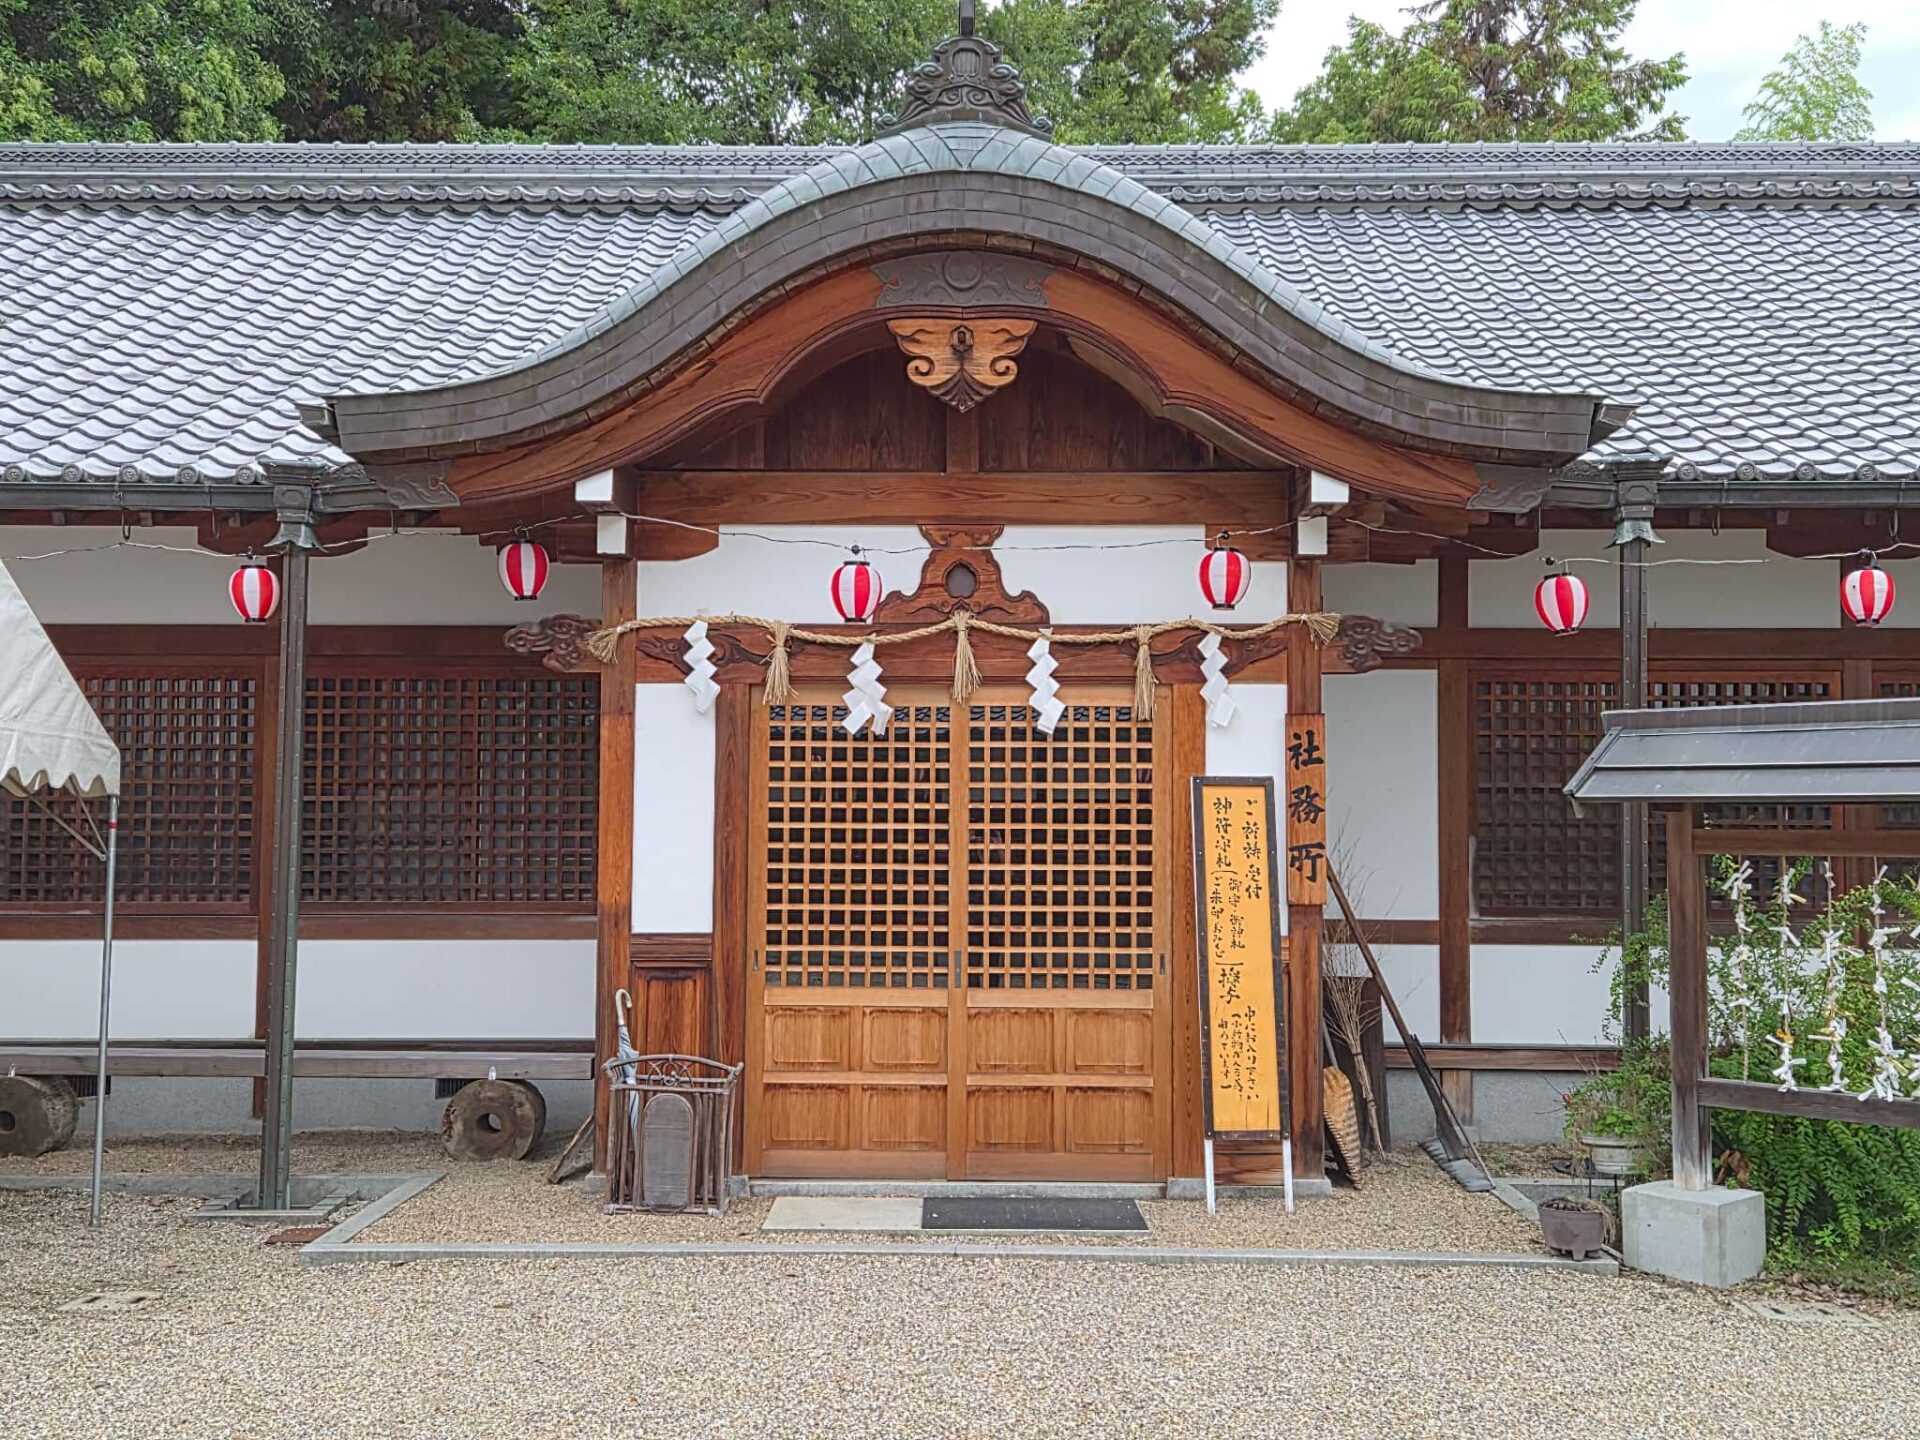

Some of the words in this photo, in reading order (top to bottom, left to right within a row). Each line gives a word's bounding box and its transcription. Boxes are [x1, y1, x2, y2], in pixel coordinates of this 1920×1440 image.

[1213, 796, 1233, 869] 神符守札
[1287, 730, 1326, 883] 社務所
[1244, 1005, 1260, 1100] 中にお入り下さい
